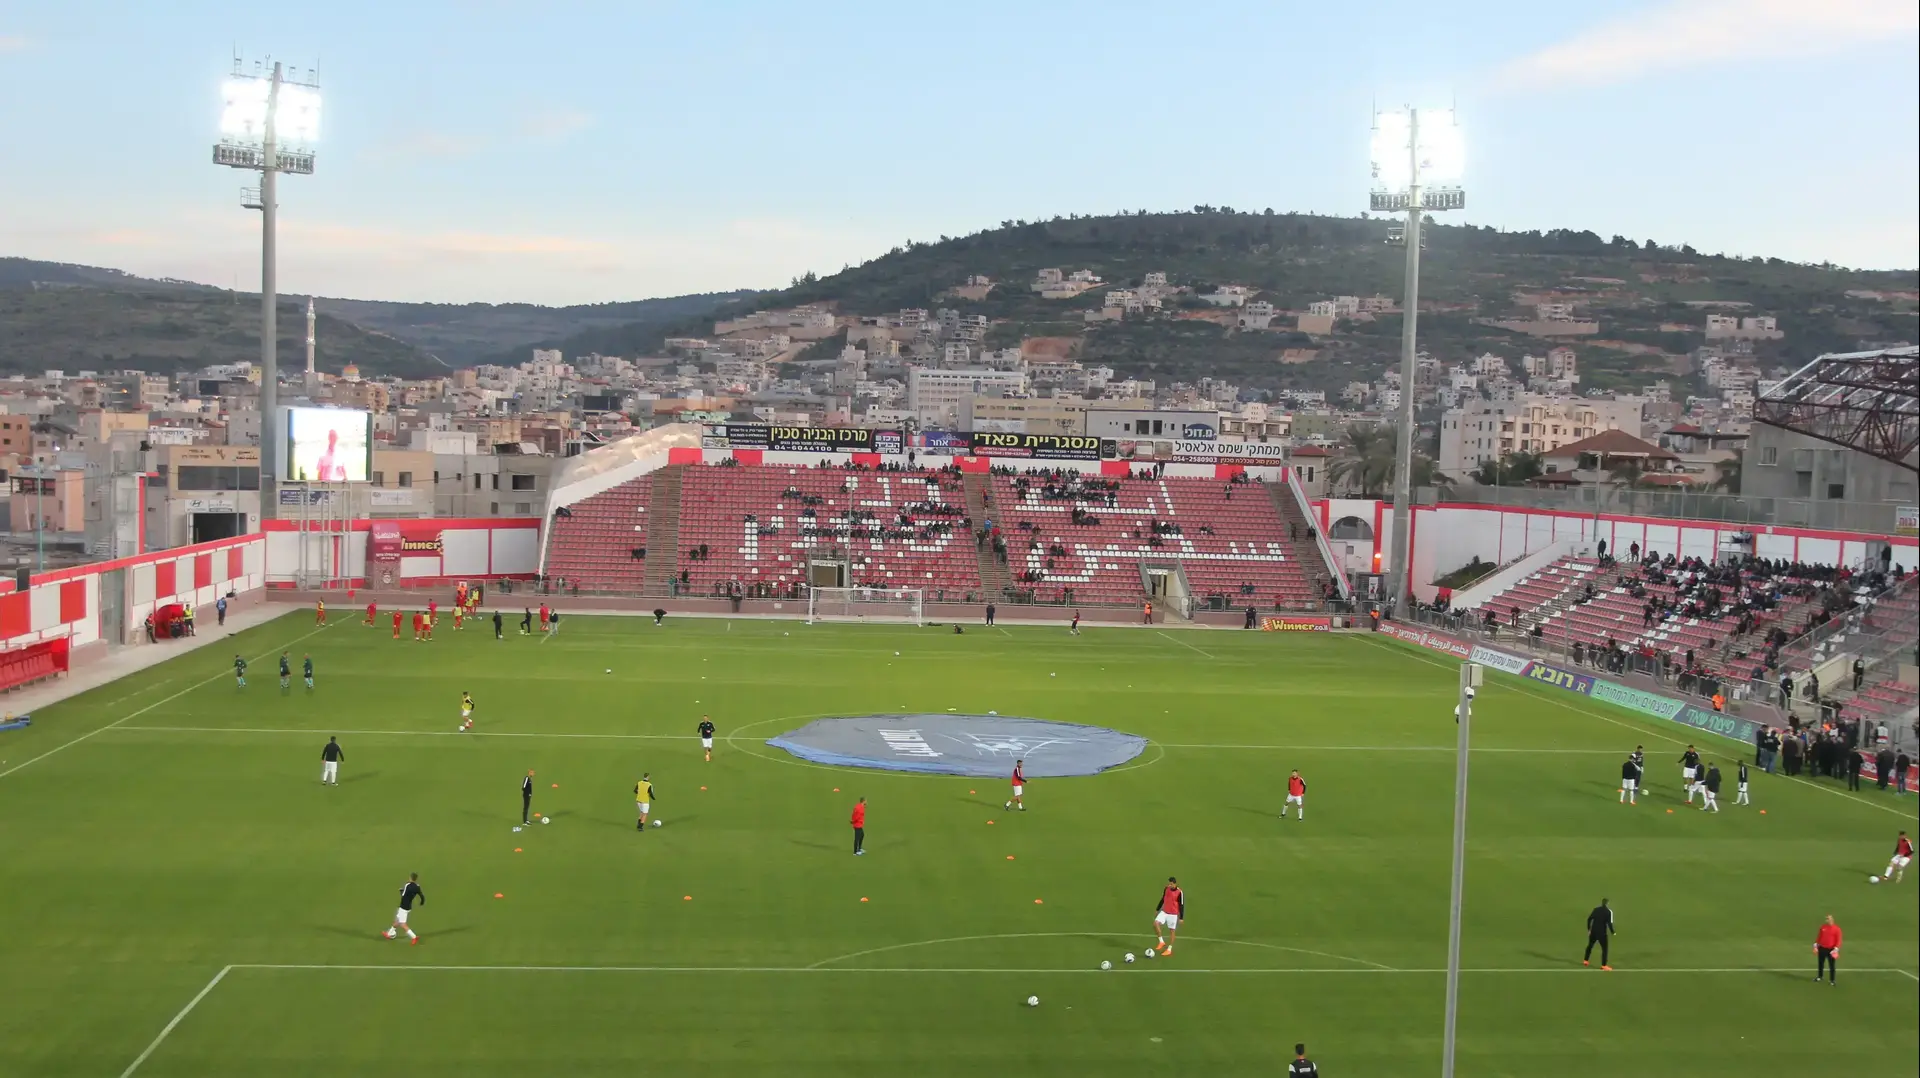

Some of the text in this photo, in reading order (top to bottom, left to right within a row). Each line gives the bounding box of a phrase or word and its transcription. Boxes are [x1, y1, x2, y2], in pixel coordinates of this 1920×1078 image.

[771, 427, 800, 442] סכנין
[803, 428, 836, 441] הבניה
[840, 429, 868, 441] מרכז
[974, 433, 1099, 449] מסגריית פאדי
[774, 444, 832, 452] 04-6044100
[930, 439, 949, 447] אחר
[1175, 440, 1281, 457] ממתקי שמס אלאסיל
[1172, 455, 1218, 463] 054-2580903
[401, 537, 441, 550] inner
[1530, 664, 1575, 688] רובא
[1576, 681, 1586, 693] R
